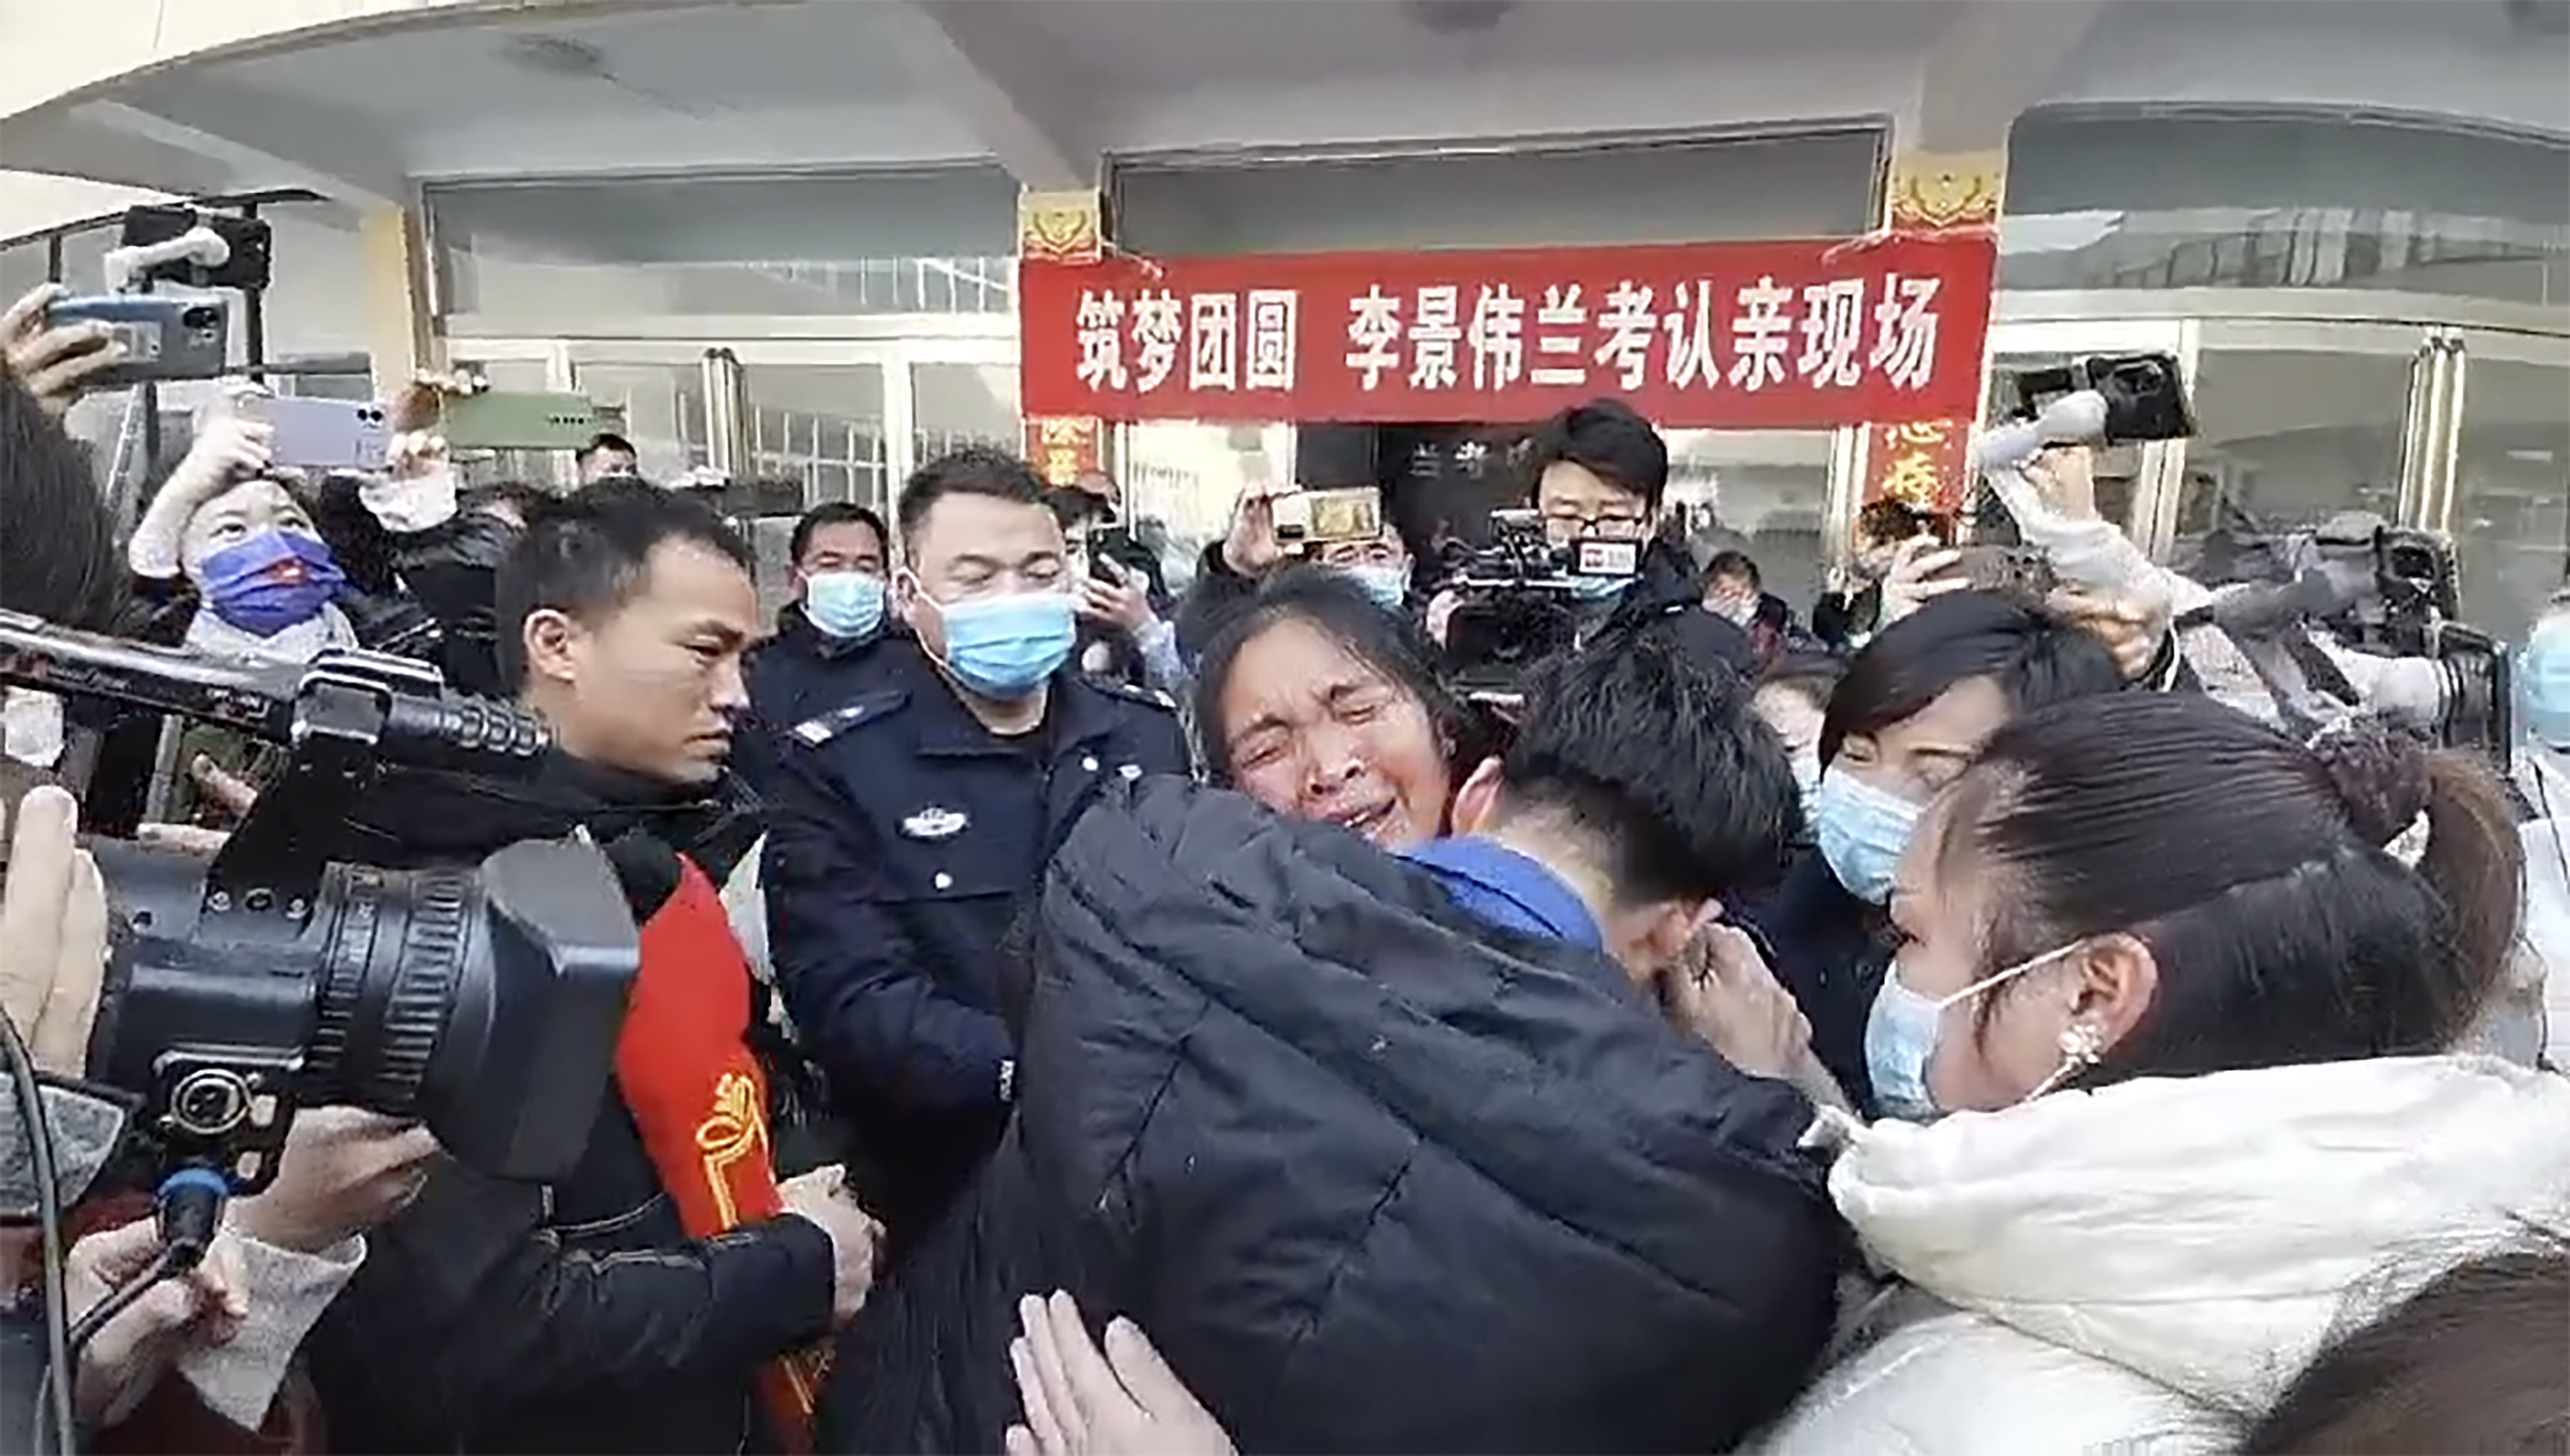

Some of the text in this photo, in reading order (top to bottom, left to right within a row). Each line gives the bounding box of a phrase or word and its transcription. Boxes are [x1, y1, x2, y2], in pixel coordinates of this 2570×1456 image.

[1076, 272, 1941, 392] 筑梦团圆 李景伟兰考认亲现场
